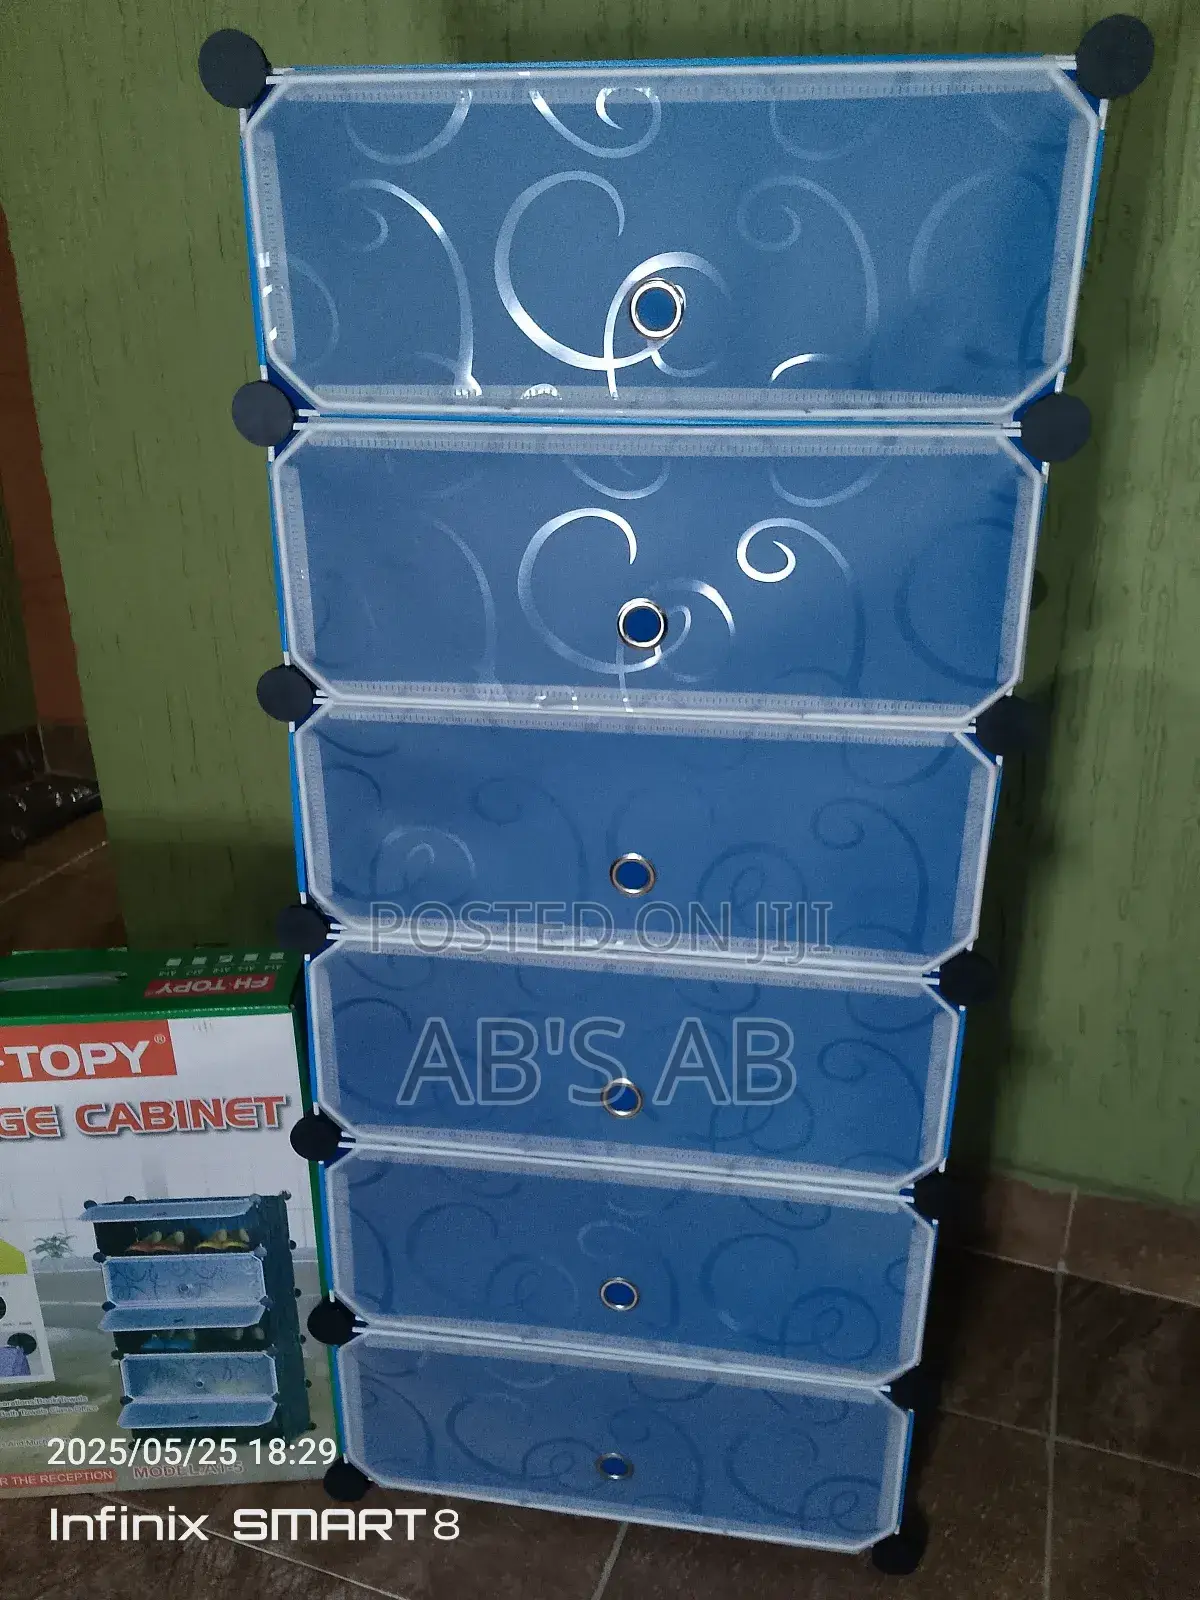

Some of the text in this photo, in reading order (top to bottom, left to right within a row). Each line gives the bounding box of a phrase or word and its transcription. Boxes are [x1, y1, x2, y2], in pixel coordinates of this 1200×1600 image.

[75, 1095, 288, 1137] CABINET
[11, 1475, 38, 1486] THE
[39, 1470, 113, 1485] RECEPTION
